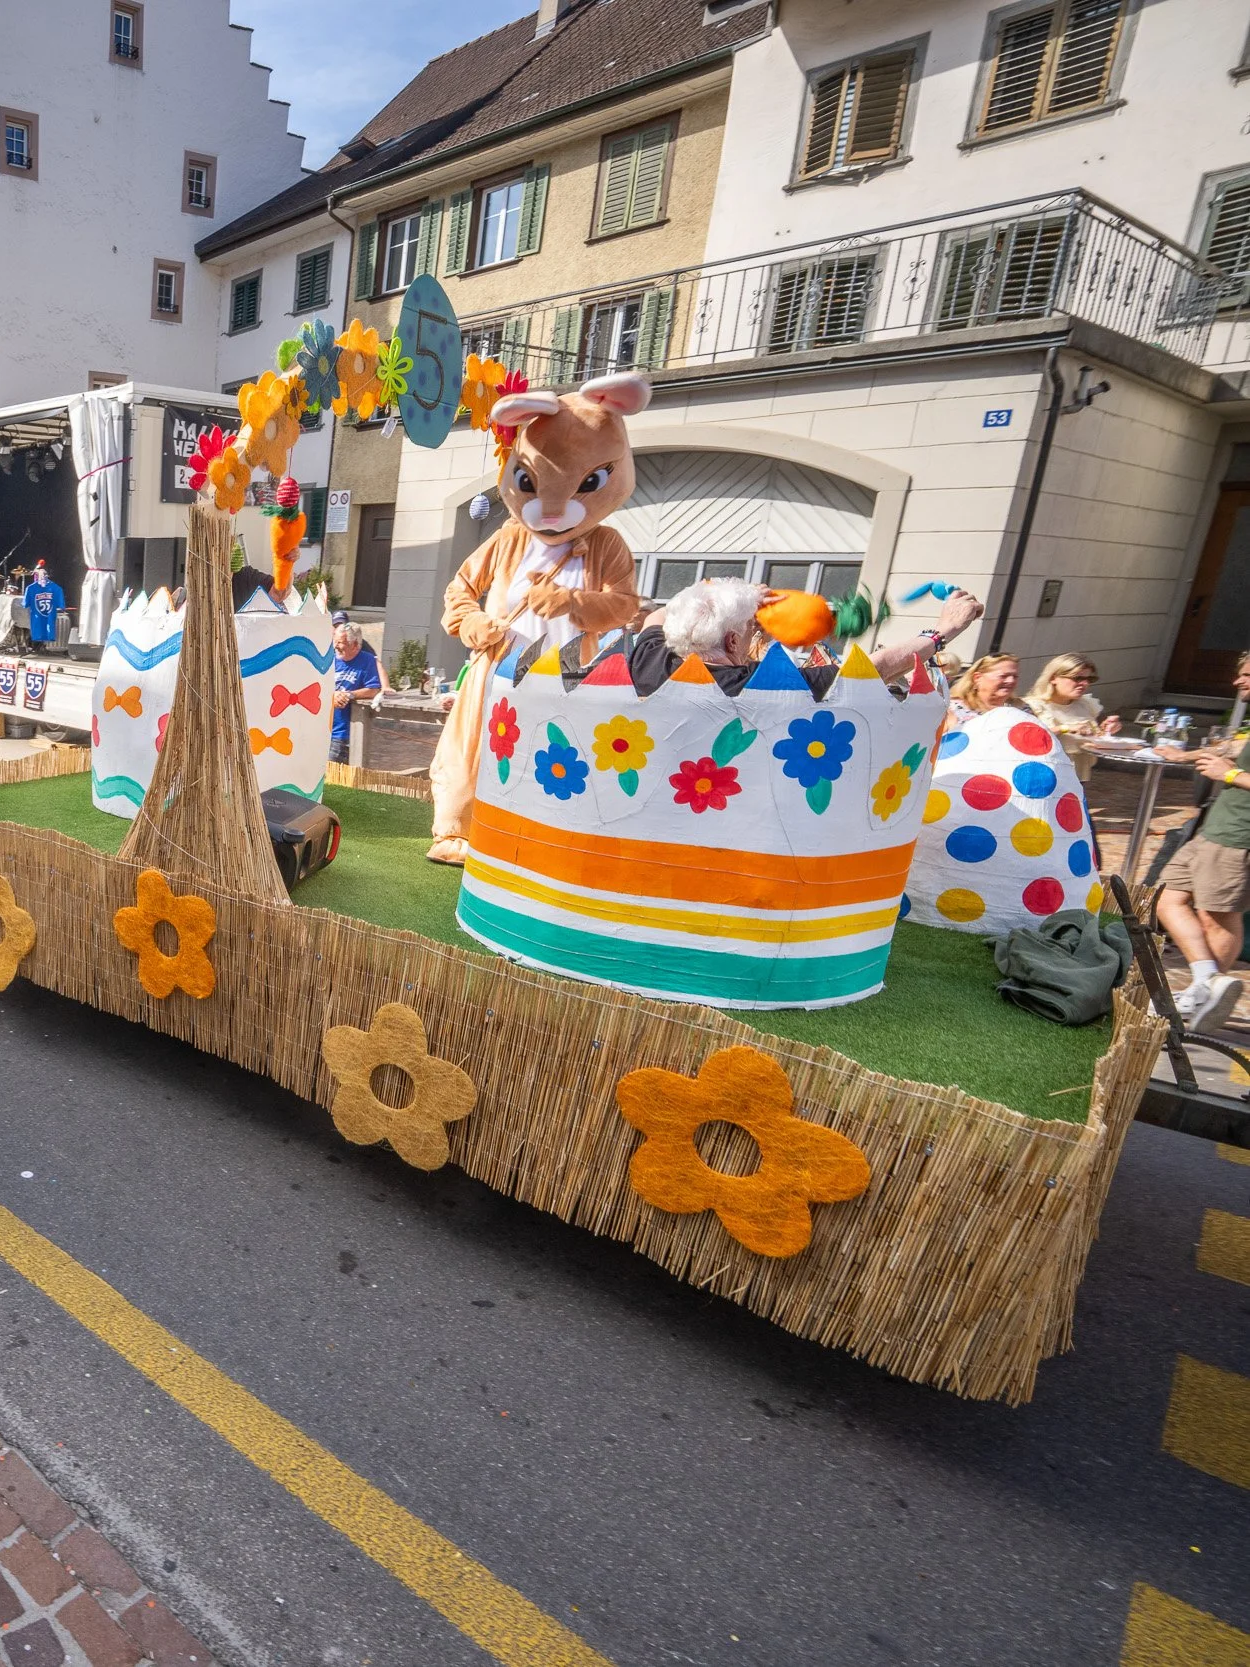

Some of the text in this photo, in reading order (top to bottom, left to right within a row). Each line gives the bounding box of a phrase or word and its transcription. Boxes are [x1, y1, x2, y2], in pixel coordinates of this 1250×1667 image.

[413, 309, 447, 411] 5
[986, 411, 1009, 425] 53
[38, 600, 51, 611] 55
[0, 670, 13, 687] 55
[27, 675, 42, 692] 55
